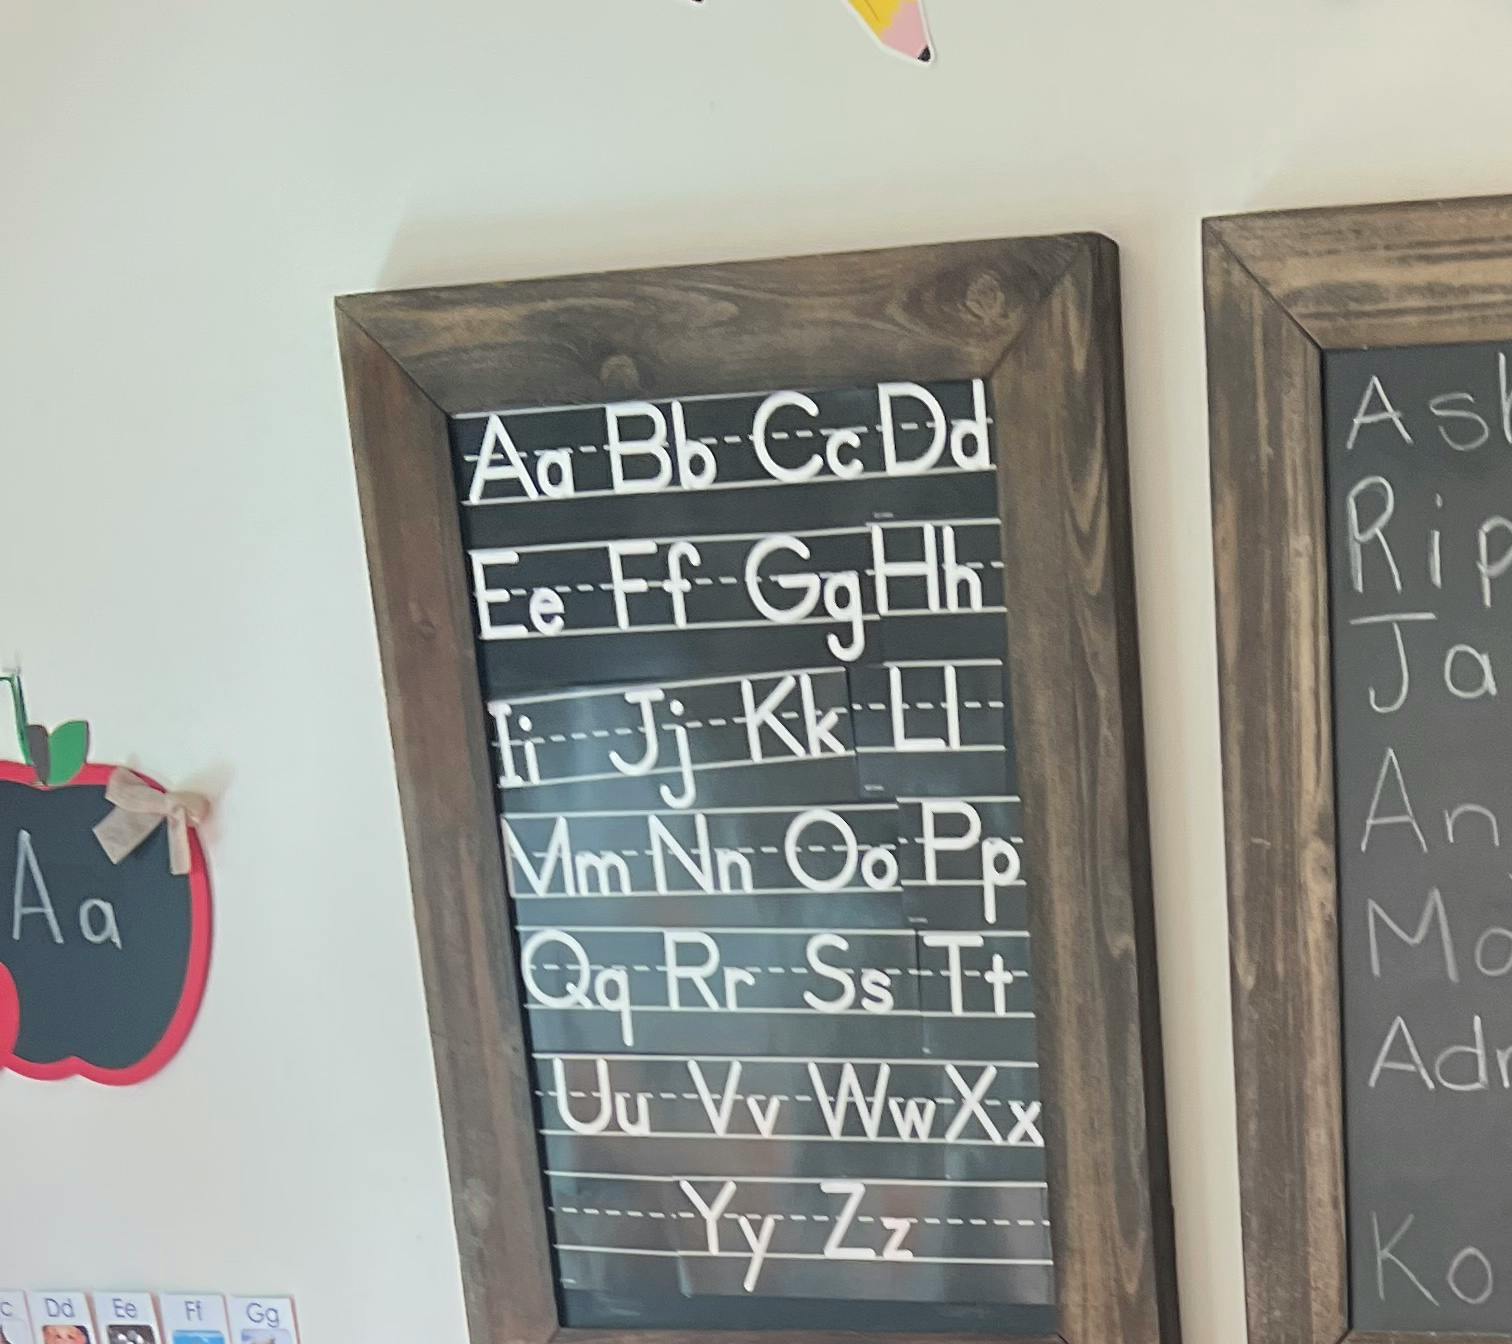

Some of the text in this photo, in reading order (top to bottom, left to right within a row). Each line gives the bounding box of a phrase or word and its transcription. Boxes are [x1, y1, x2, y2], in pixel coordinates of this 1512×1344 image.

[469, 378, 992, 502] Aa Bb Cc Dd
[469, 523, 982, 662] Ee Ff Gg Hh
[488, 701, 540, 788] Ii
[609, 689, 696, 810] Jj
[741, 675, 846, 763] Kk
[13, 829, 122, 949] Aa
[500, 800, 1020, 924] Mm Nn Oo Pp
[522, 929, 1014, 1046] Qq Rr Ss Tt
[554, 1059, 1045, 1146] Uu Vv Ww Xx
[681, 1180, 914, 1293] Yy Zz
[246, 1302, 280, 1328] Gg
